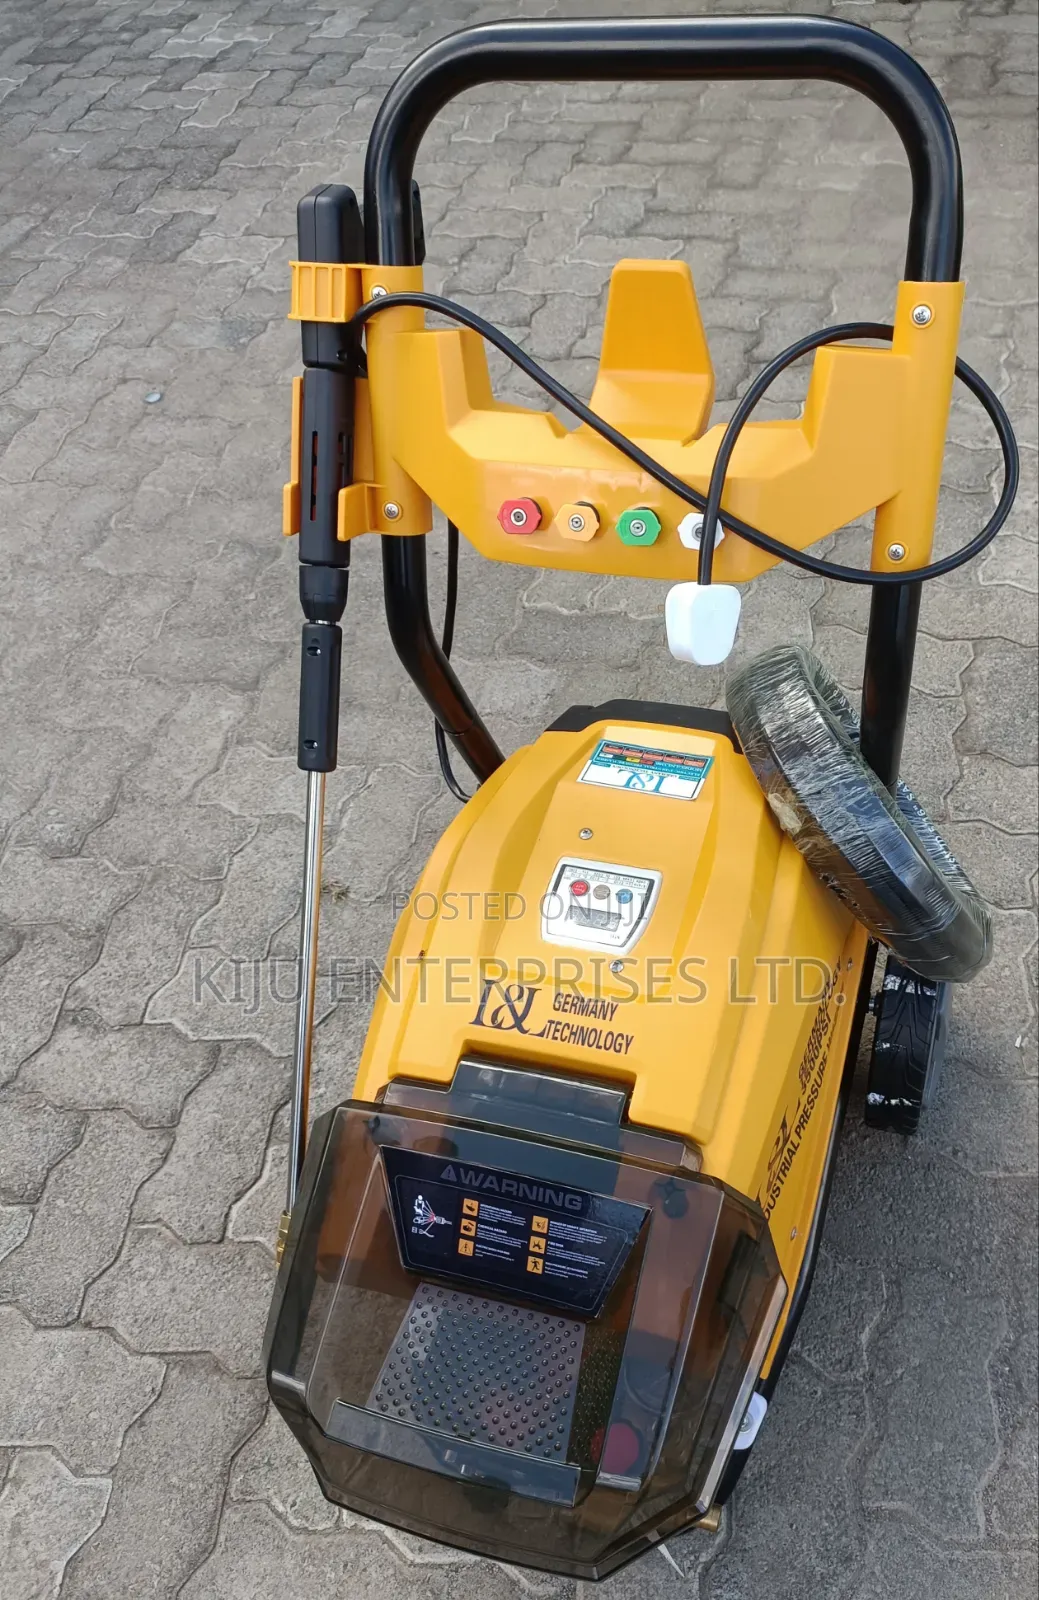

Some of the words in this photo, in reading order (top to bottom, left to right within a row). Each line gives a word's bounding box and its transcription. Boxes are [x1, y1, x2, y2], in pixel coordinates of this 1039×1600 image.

[469, 979, 547, 1038] I&L
[553, 992, 618, 1023] GERMANY
[546, 1018, 634, 1055] TECHNOLOGY
[764, 1140, 801, 1221] DUSTRIAL
[794, 1051, 828, 1141] PRESSURE
[460, 1167, 583, 1210] WARNING
